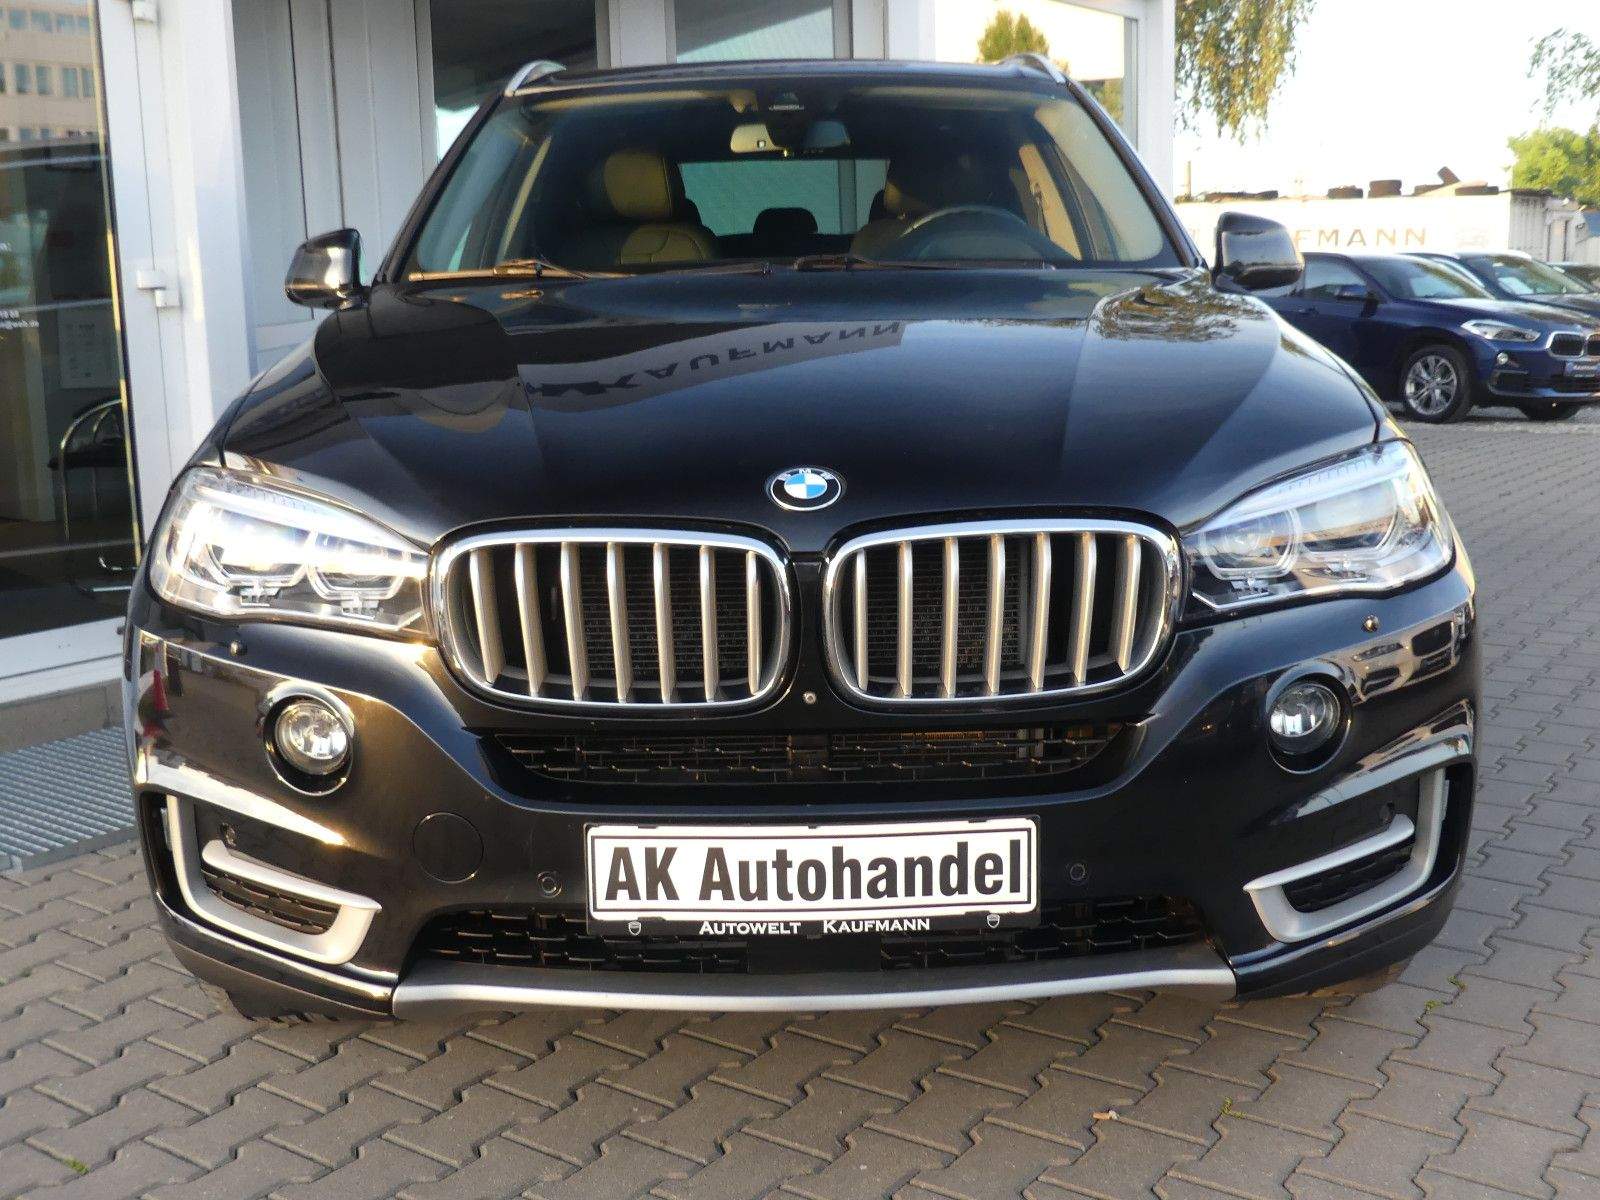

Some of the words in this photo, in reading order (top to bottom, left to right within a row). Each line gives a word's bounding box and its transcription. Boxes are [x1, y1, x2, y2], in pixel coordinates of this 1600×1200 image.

[1293, 228, 1427, 247] FMANN
[605, 846, 679, 901] AK
[699, 839, 1021, 902] Autohandel
